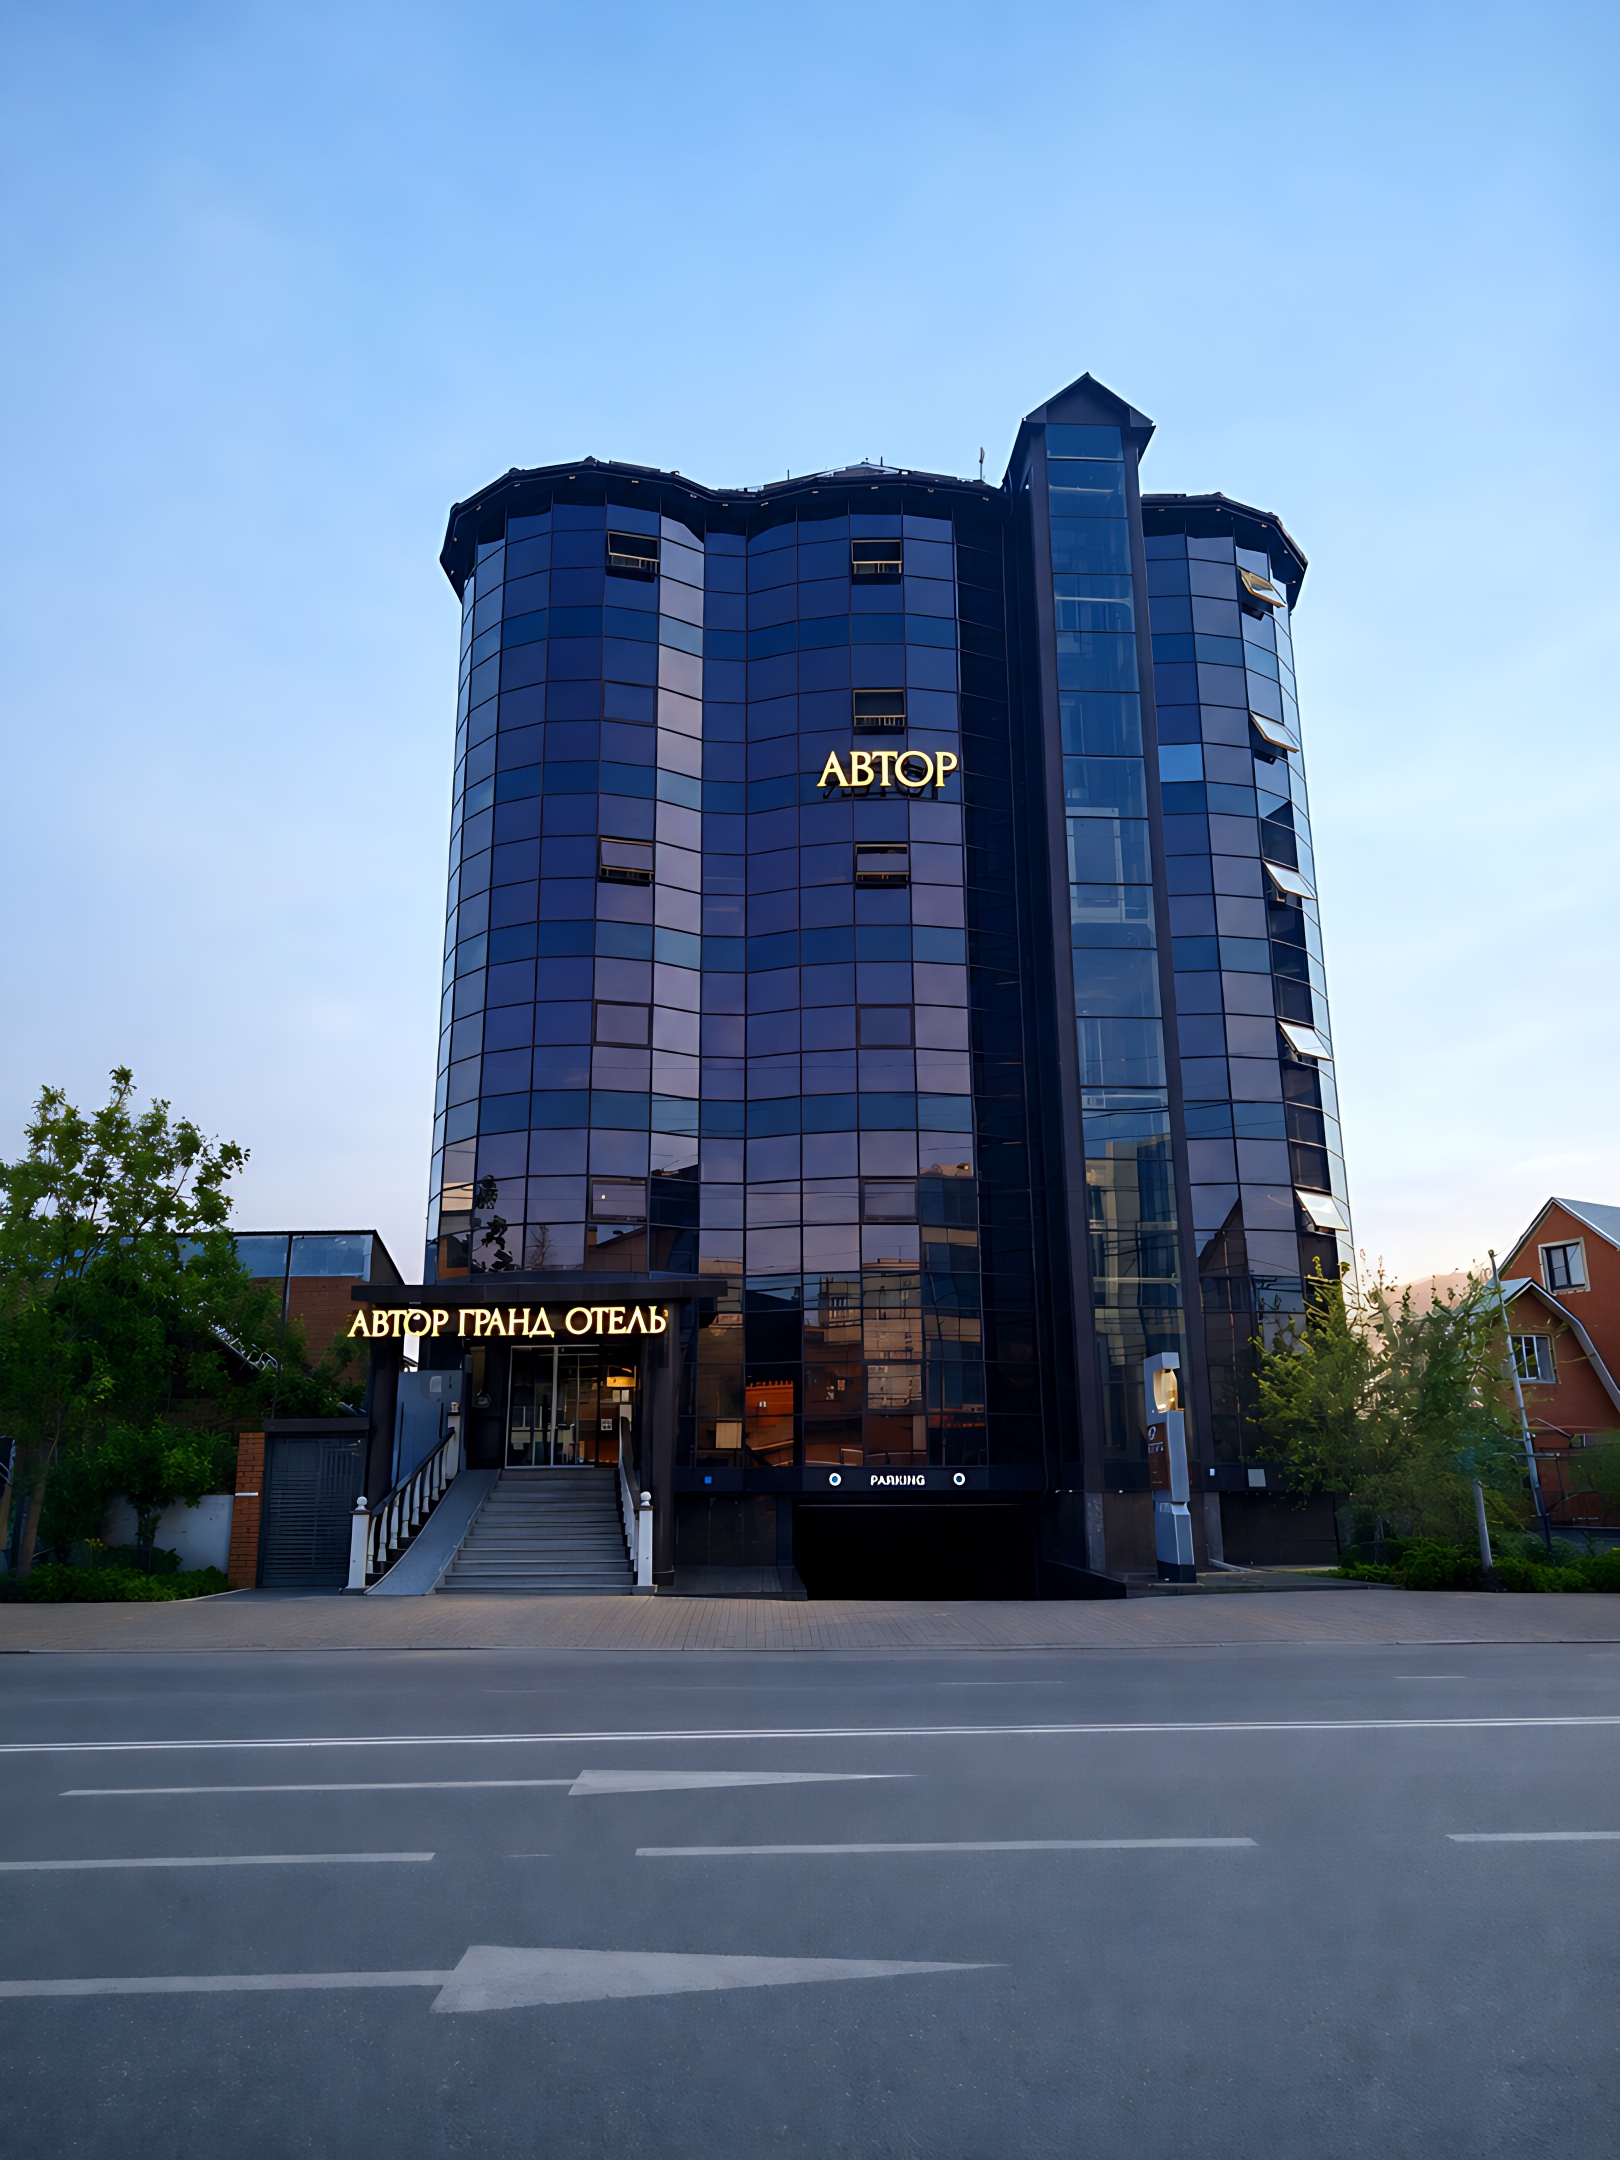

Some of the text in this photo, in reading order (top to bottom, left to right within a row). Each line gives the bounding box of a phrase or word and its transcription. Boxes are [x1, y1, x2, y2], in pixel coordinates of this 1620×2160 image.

[816, 750, 958, 788] АВТОР
[347, 1305, 668, 1338] АВТОР ГРАНД ОТЕЛЬ
[870, 1474, 926, 1486] PARKING
